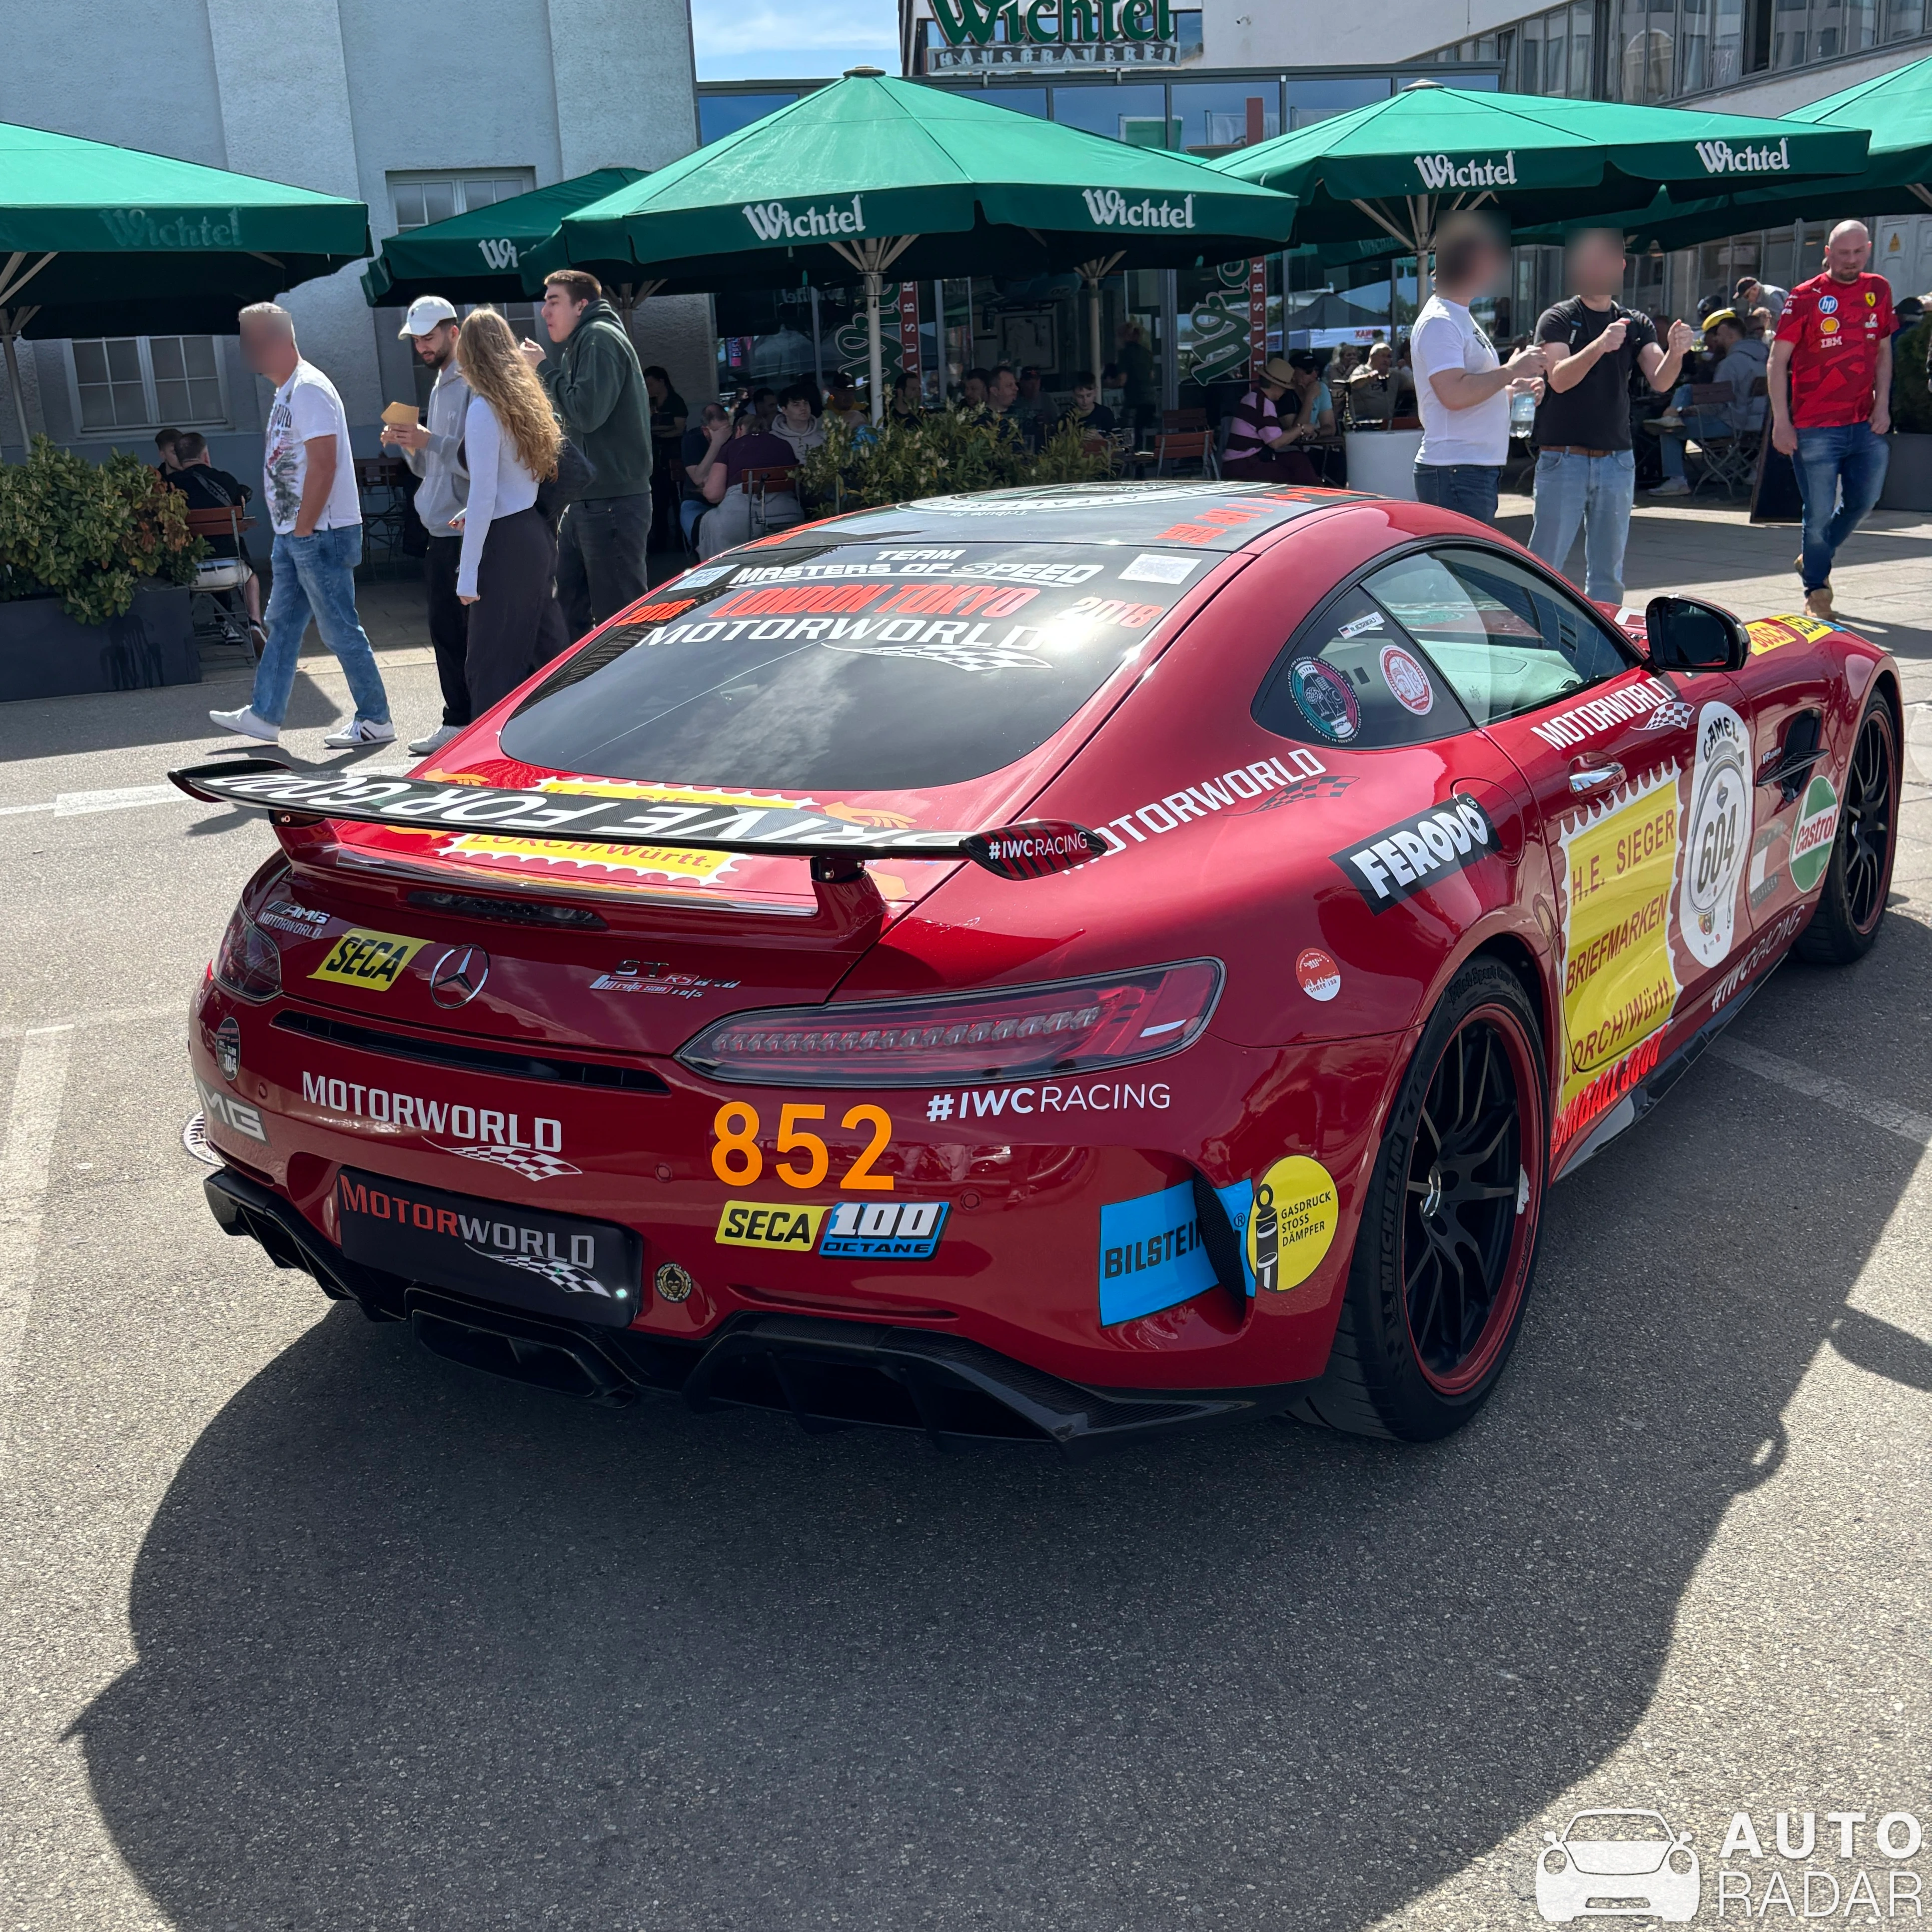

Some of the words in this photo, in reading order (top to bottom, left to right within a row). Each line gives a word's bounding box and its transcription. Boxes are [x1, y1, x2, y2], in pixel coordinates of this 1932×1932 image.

[931, 0, 1175, 46] Wichtel
[939, 44, 1172, 65] HAUSBRAUEREI
[1413, 150, 1518, 189] Wichtel
[1696, 137, 1791, 173] Wichtel
[99, 207, 243, 249] Wichtel
[742, 194, 866, 241] Wichtel
[1082, 189, 1196, 229] Wichtel
[1822, 297, 1835, 309] hp
[1820, 335, 1843, 348] IBM
[730, 563, 893, 585] MASTERS
[901, 563, 955, 574] OF
[961, 562, 1105, 584] SPEED
[875, 549, 967, 561] TEAM
[613, 598, 697, 627] 2018
[709, 584, 895, 619] LONDON
[874, 583, 1041, 618] TOKYO
[1056, 596, 1164, 629] 2018
[634, 617, 1049, 652] MOTORWORLD
[1530, 677, 1678, 751] MOTORWORLD
[1703, 716, 1739, 763] CAMEL
[203, 775, 412, 807] GOOD
[380, 788, 622, 828] FOR
[1061, 748, 1326, 876] OTORWORLD
[1349, 803, 1489, 900] FERODO
[1697, 803, 1737, 894] 604
[1795, 808, 1838, 856] Castrol
[1571, 855, 1605, 907] H.E.
[1616, 809, 1675, 875] SIEGER
[257, 912, 323, 939] MOTORWORLD
[284, 906, 331, 925] AMG
[325, 937, 409, 982] SECA
[1565, 890, 1669, 997] BRIEFMARKEN
[615, 960, 670, 977] GT
[198, 1079, 267, 1142] MG
[302, 1071, 562, 1153] MOTORWORLD
[711, 1101, 895, 1190] 852
[340, 1173, 596, 1270] MOTORWORLD
[724, 1208, 813, 1245] SECA
[829, 1202, 943, 1239] 100
[1280, 1191, 1332, 1219] GASDRUCK
[1281, 1213, 1310, 1234] STOSS
[1380, 1130, 1405, 1294] MICHELIN
[823, 1242, 933, 1254] OCTANE
[1282, 1220, 1325, 1247] DÄMPFER
